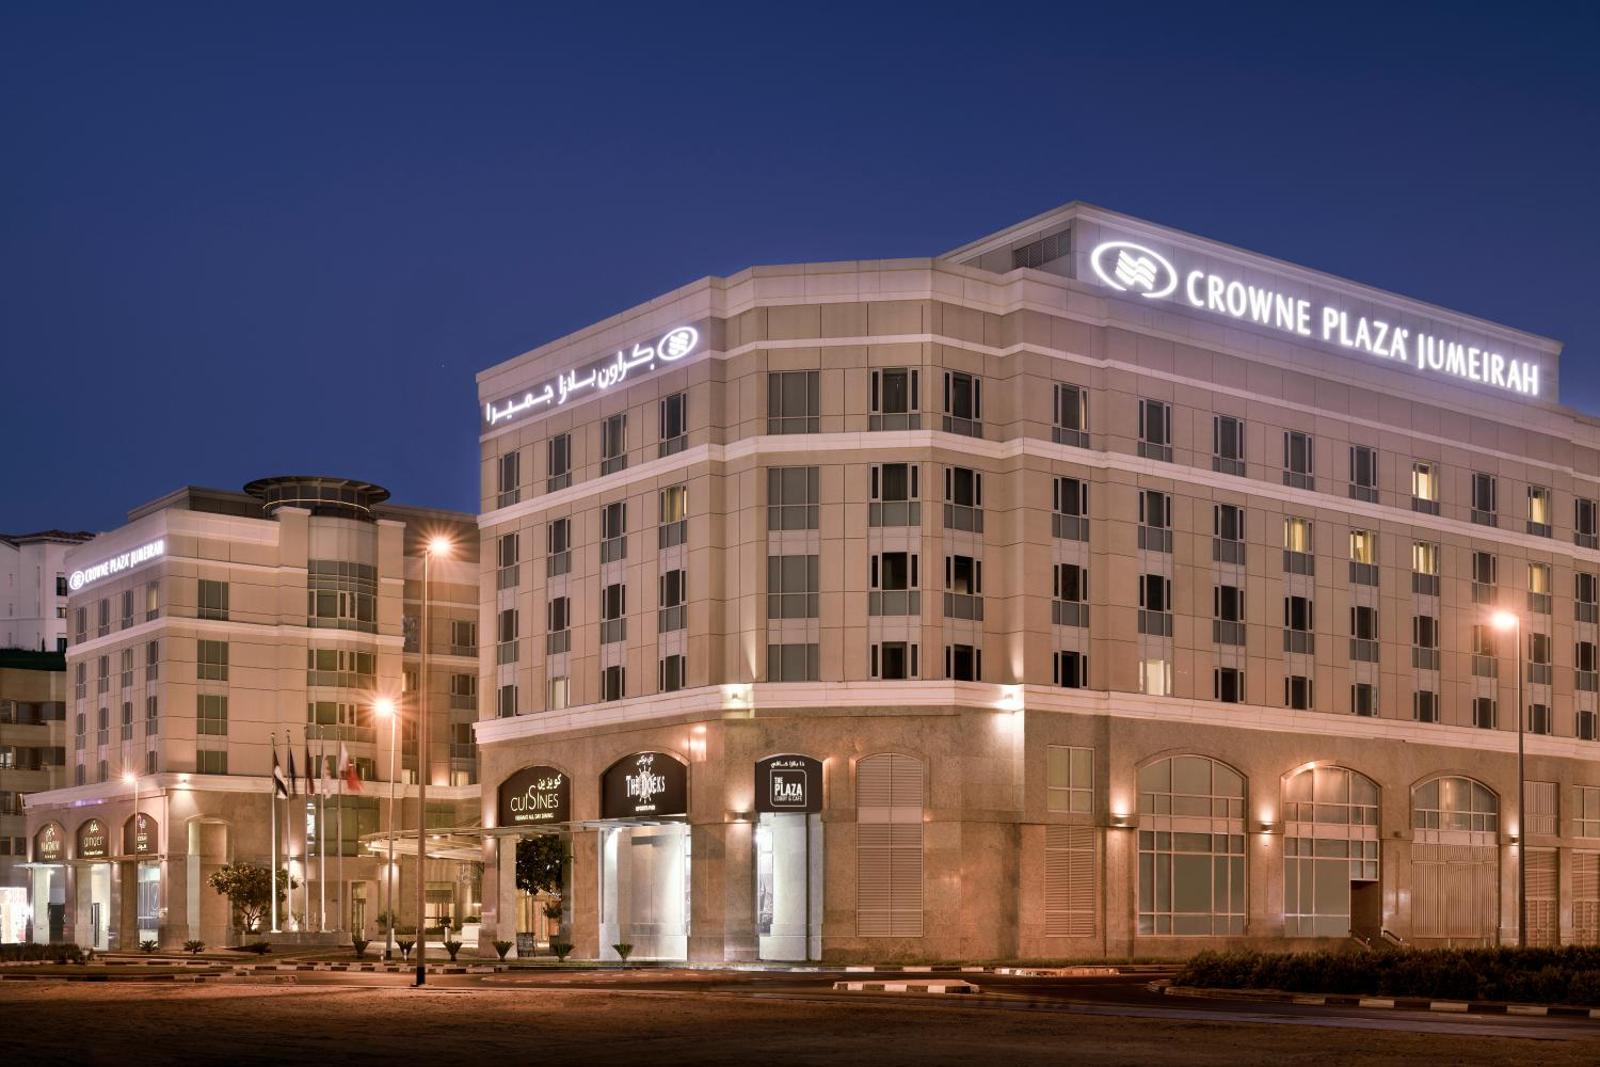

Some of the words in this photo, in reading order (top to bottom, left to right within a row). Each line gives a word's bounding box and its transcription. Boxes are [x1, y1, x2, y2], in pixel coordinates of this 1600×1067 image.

[1186, 270, 1311, 335] CROWNE
[1322, 306, 1408, 361] PLAZA
[1417, 333, 1539, 396] JUMEIRAH
[558, 367, 596, 405] بلازا
[598, 343, 655, 389] كراون
[485, 384, 554, 425] جميرا
[85, 561, 109, 583] CROWNE
[109, 553, 130, 574] PLAZA
[130, 540, 164, 568] JUMEIRAH
[510, 784, 559, 812] CUISINES
[774, 783, 803, 796] PLAZA
